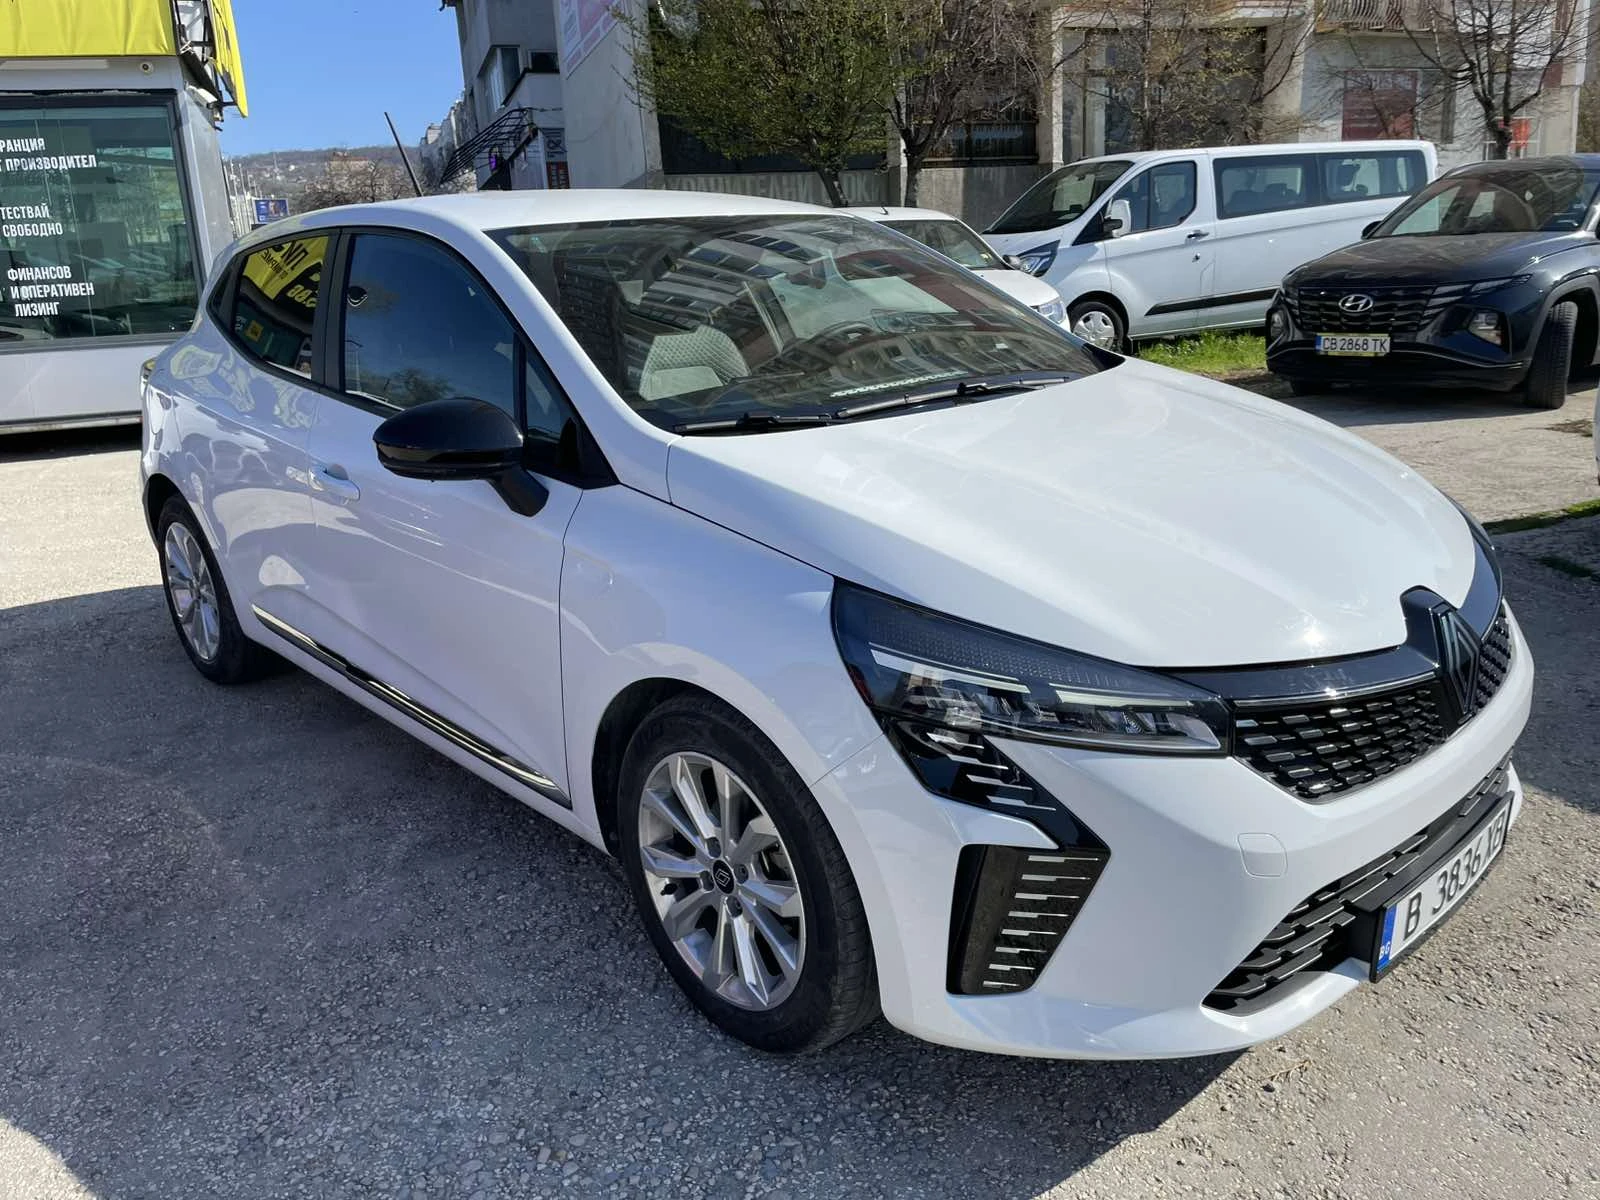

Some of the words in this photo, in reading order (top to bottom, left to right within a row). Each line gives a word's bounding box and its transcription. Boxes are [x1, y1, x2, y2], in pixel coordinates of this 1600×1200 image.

[5, 154, 97, 171] ПРОИЗВОДИТЕЛ
[0, 202, 50, 219] ТЕСТВАЙ
[2, 222, 63, 237] СВОБОДНО
[7, 265, 72, 281] ФИНАНСОВ
[10, 285, 20, 299] И
[20, 282, 95, 299] ОПЕРАТИВЕН
[14, 301, 60, 317] ЛИЗИНГ
[1323, 337, 1337, 350] CB
[1340, 338, 1369, 351] 2868
[1371, 339, 1388, 352] TK
[1404, 891, 1422, 941] B
[1432, 836, 1484, 915] 3836
[1378, 940, 1391, 961] BG
